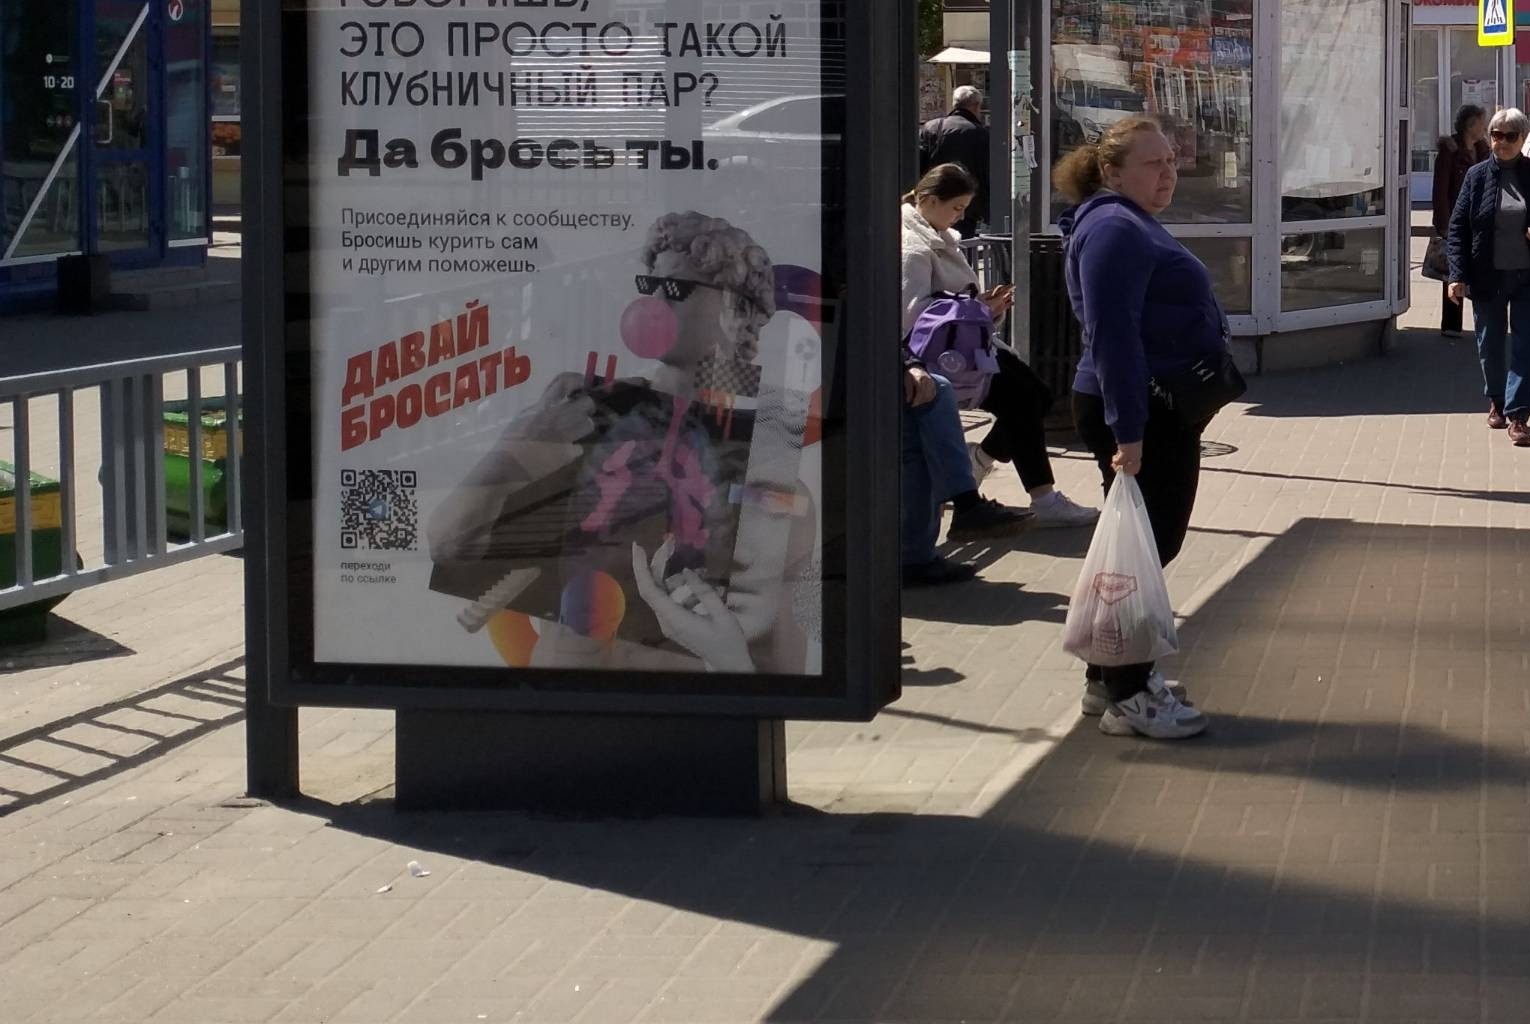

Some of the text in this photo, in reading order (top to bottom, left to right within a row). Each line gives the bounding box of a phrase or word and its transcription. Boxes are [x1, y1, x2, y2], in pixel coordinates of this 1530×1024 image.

[339, 14, 786, 57] ЭТО ПРОСТО ТАКОЙ
[622, 72, 719, 107] ПАР?
[337, 128, 719, 181] Да брось ты.
[341, 207, 635, 231] Присоединяйся к сообществу.
[341, 231, 538, 253] Бросишь курить сам
[342, 257, 540, 275] и другим поможешь.
[341, 298, 490, 407] ДАВАЙ
[341, 346, 532, 452] БРОСАТЬ
[340, 561, 391, 572] переходи
[340, 575, 397, 583] по ссылке
